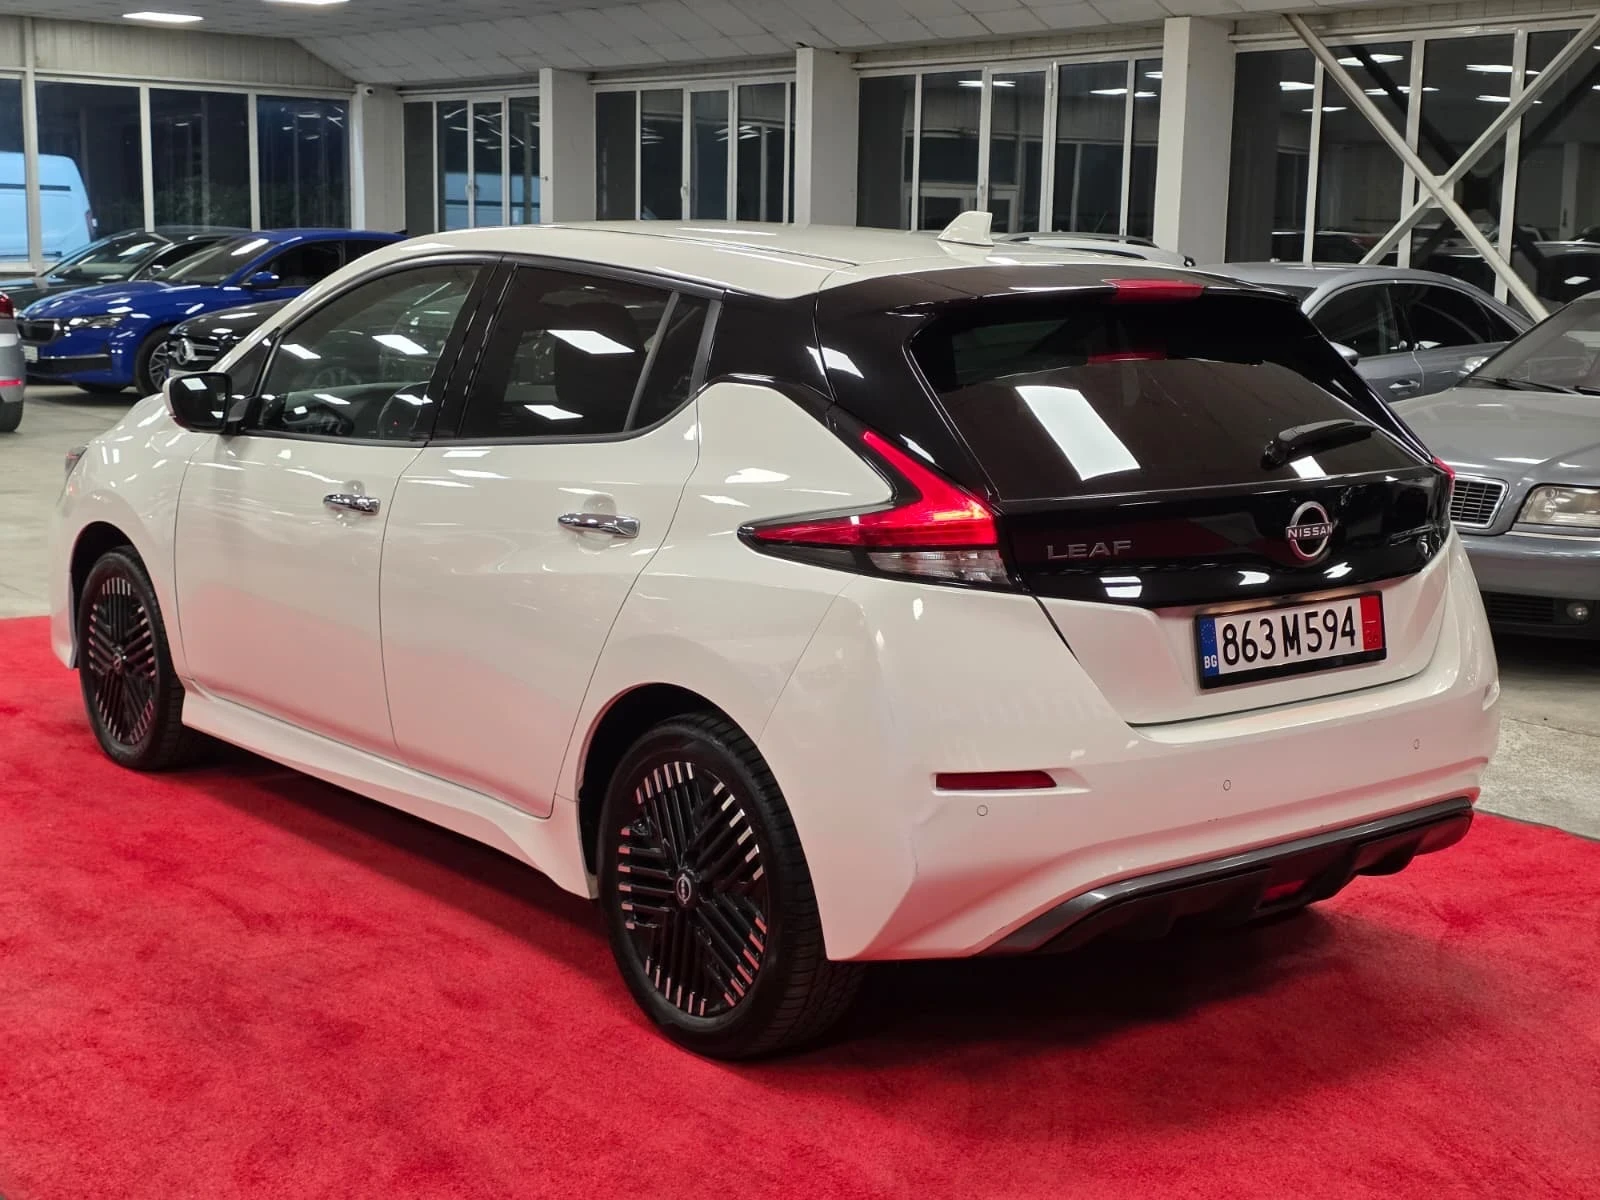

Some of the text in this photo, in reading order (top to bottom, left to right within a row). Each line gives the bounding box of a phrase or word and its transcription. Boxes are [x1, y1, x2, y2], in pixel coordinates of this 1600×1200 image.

[1287, 524, 1333, 539] NISSAN
[1047, 540, 1132, 560] LEAF
[1203, 654, 1218, 669] BG
